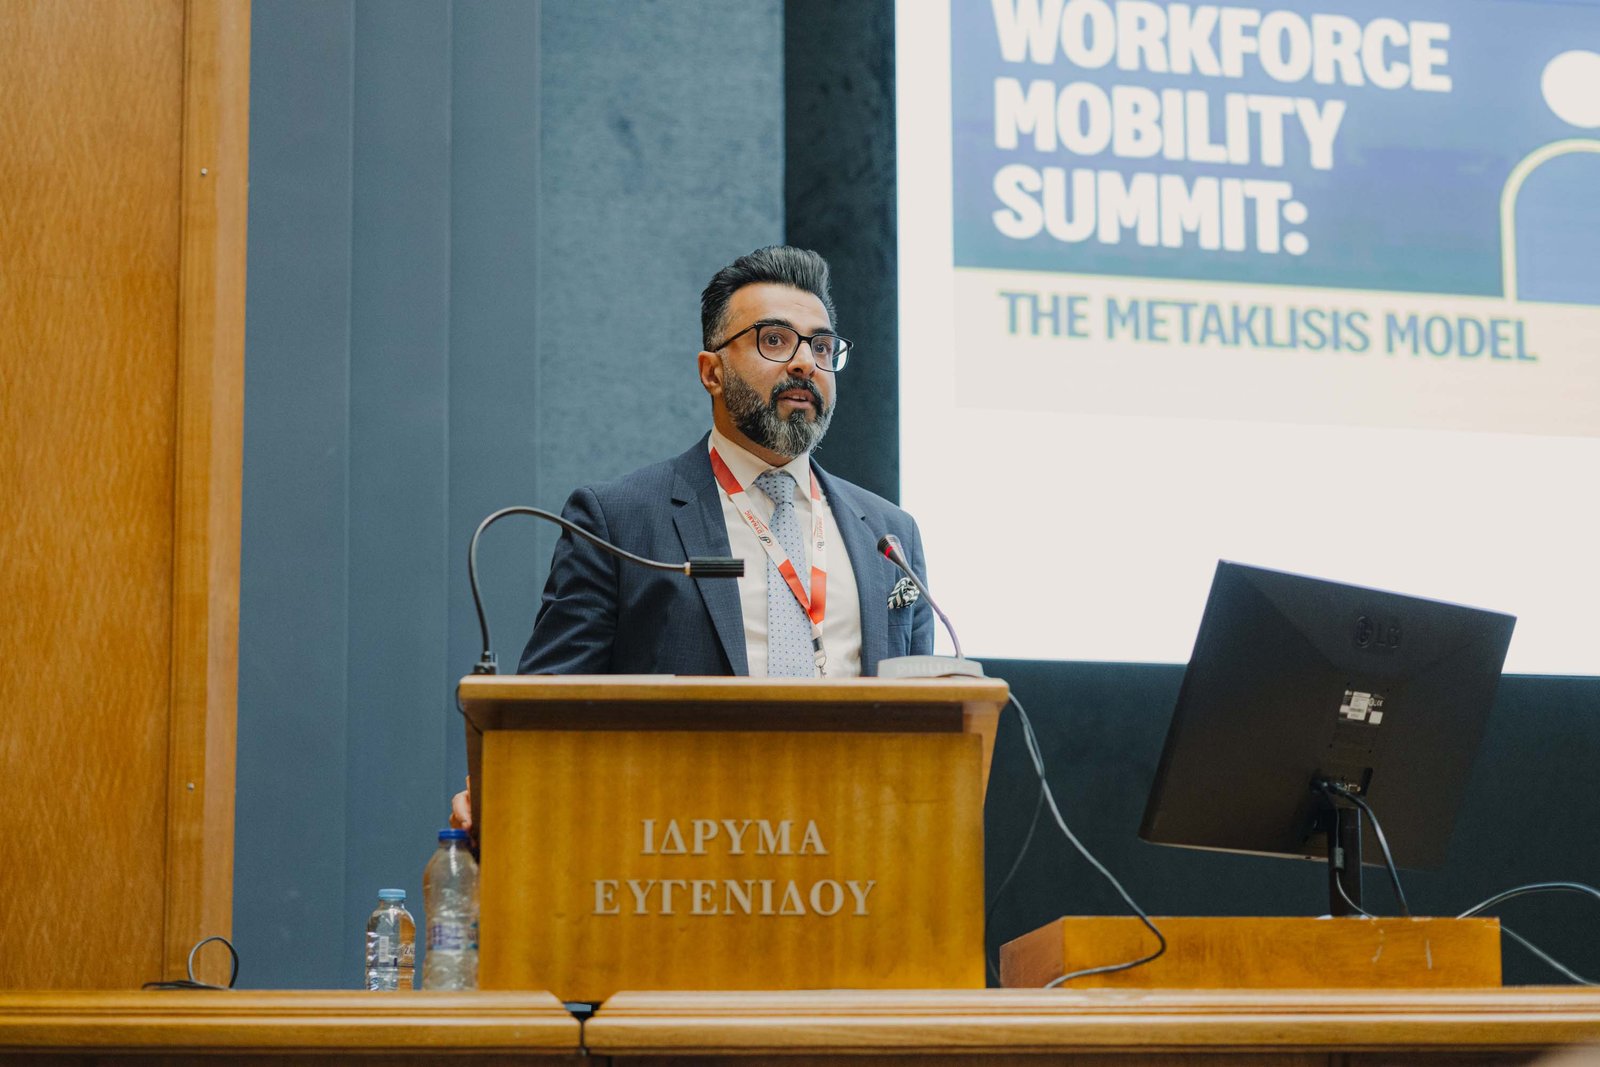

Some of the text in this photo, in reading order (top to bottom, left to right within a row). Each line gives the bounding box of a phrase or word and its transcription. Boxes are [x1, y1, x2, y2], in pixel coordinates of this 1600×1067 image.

[992, 0, 1452, 92] WORKFORCE
[994, 77, 1346, 170] MOBILITY
[992, 164, 1309, 256] SUMMIT:
[998, 290, 1538, 362] THE METAKLISIS MODEL
[641, 818, 829, 855] ΙΔΡΥΜΑ
[592, 879, 877, 916] ΕΥΓΕΝΙΔΟΥ
